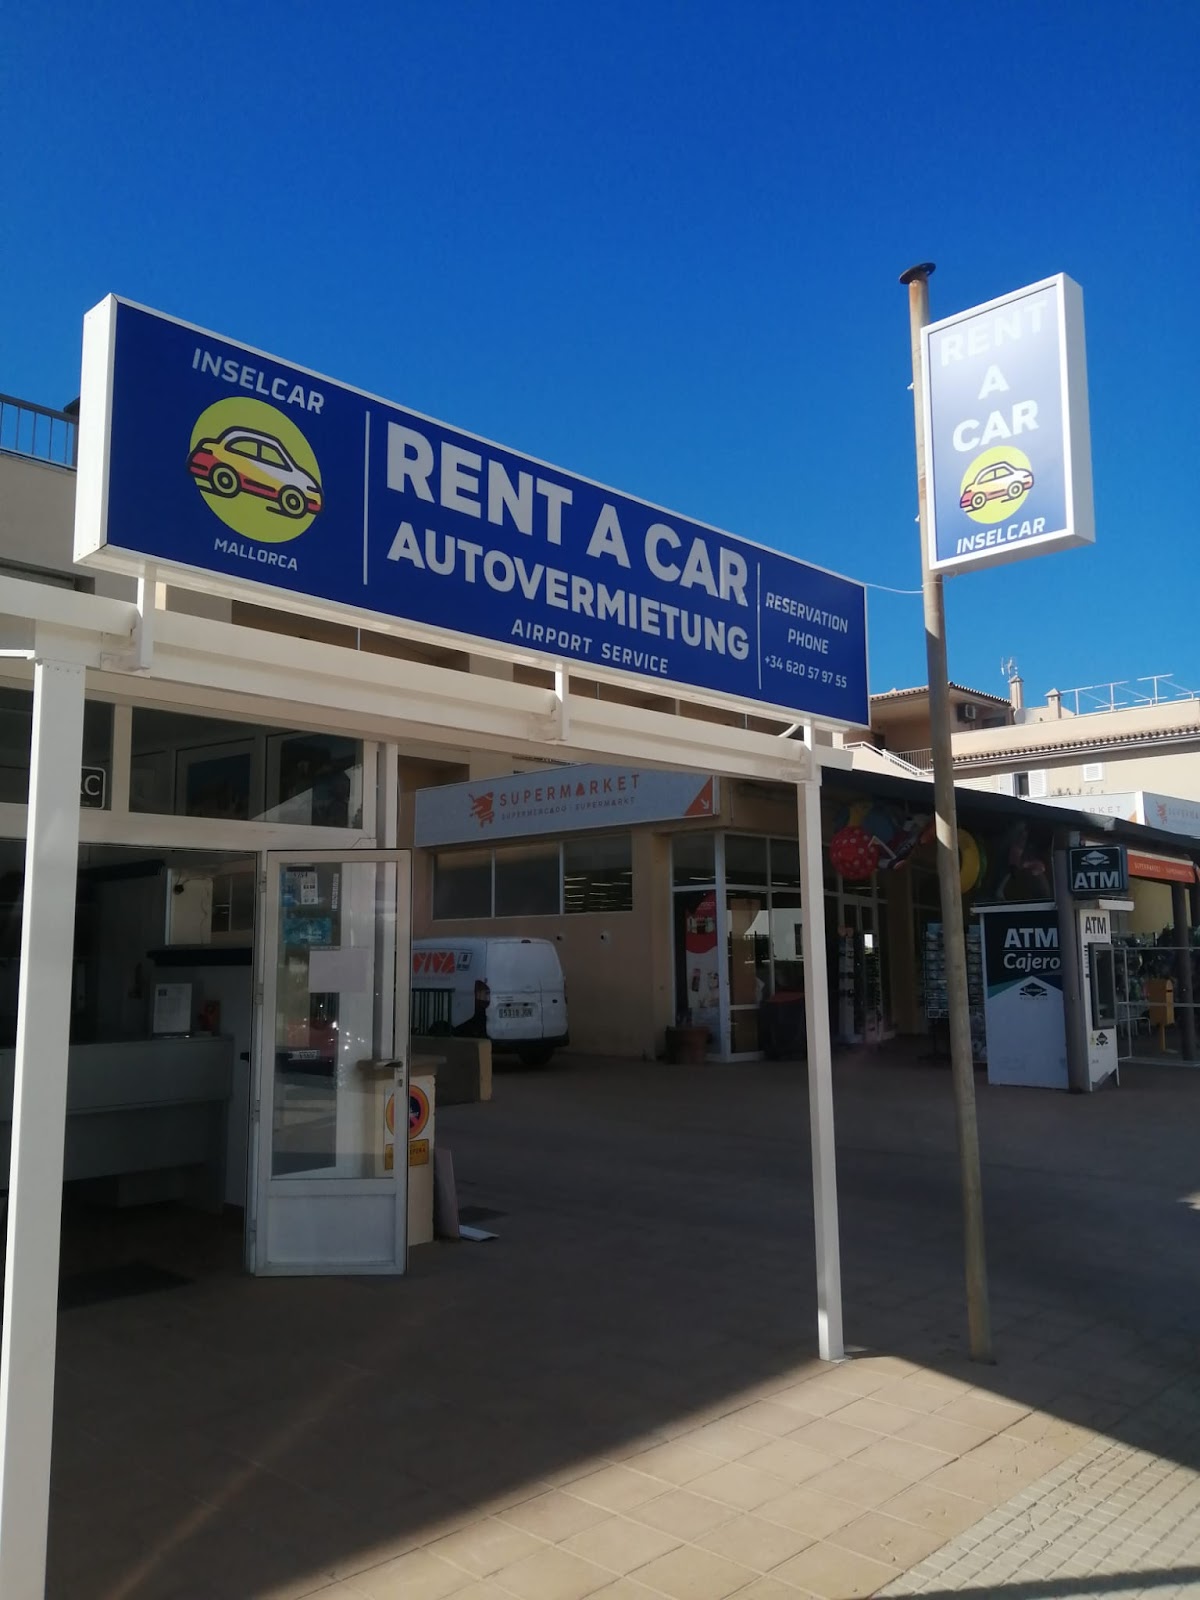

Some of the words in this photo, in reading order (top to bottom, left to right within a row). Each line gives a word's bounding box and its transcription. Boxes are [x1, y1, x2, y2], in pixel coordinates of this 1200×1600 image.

[941, 302, 1047, 366] RENT
[192, 348, 325, 415] INSELCAR
[978, 364, 1010, 400] A
[953, 399, 1039, 452] CAR
[387, 421, 573, 546] RENT
[586, 503, 631, 568] A
[645, 523, 748, 607] CAR
[956, 517, 1046, 554] INSELCAR
[214, 538, 298, 571] MALLORCA
[386, 521, 749, 660] AUTOVERMIETUNG
[765, 592, 849, 634] RESERVATION
[511, 618, 592, 654] AIRPORT
[602, 642, 669, 674] SERVICE
[788, 629, 829, 655] PHONE
[764, 655, 783, 671] +34
[786, 659, 806, 677] 620
[808, 666, 820, 681] 57
[821, 669, 834, 684] 97
[835, 674, 848, 688] 55
[499, 774, 641, 807] SUPERMARKET
[1074, 871, 1120, 889] ATM
[1004, 927, 1058, 948] ATM
[1085, 916, 1107, 935] ATM
[1003, 953, 1061, 972] Cajero
